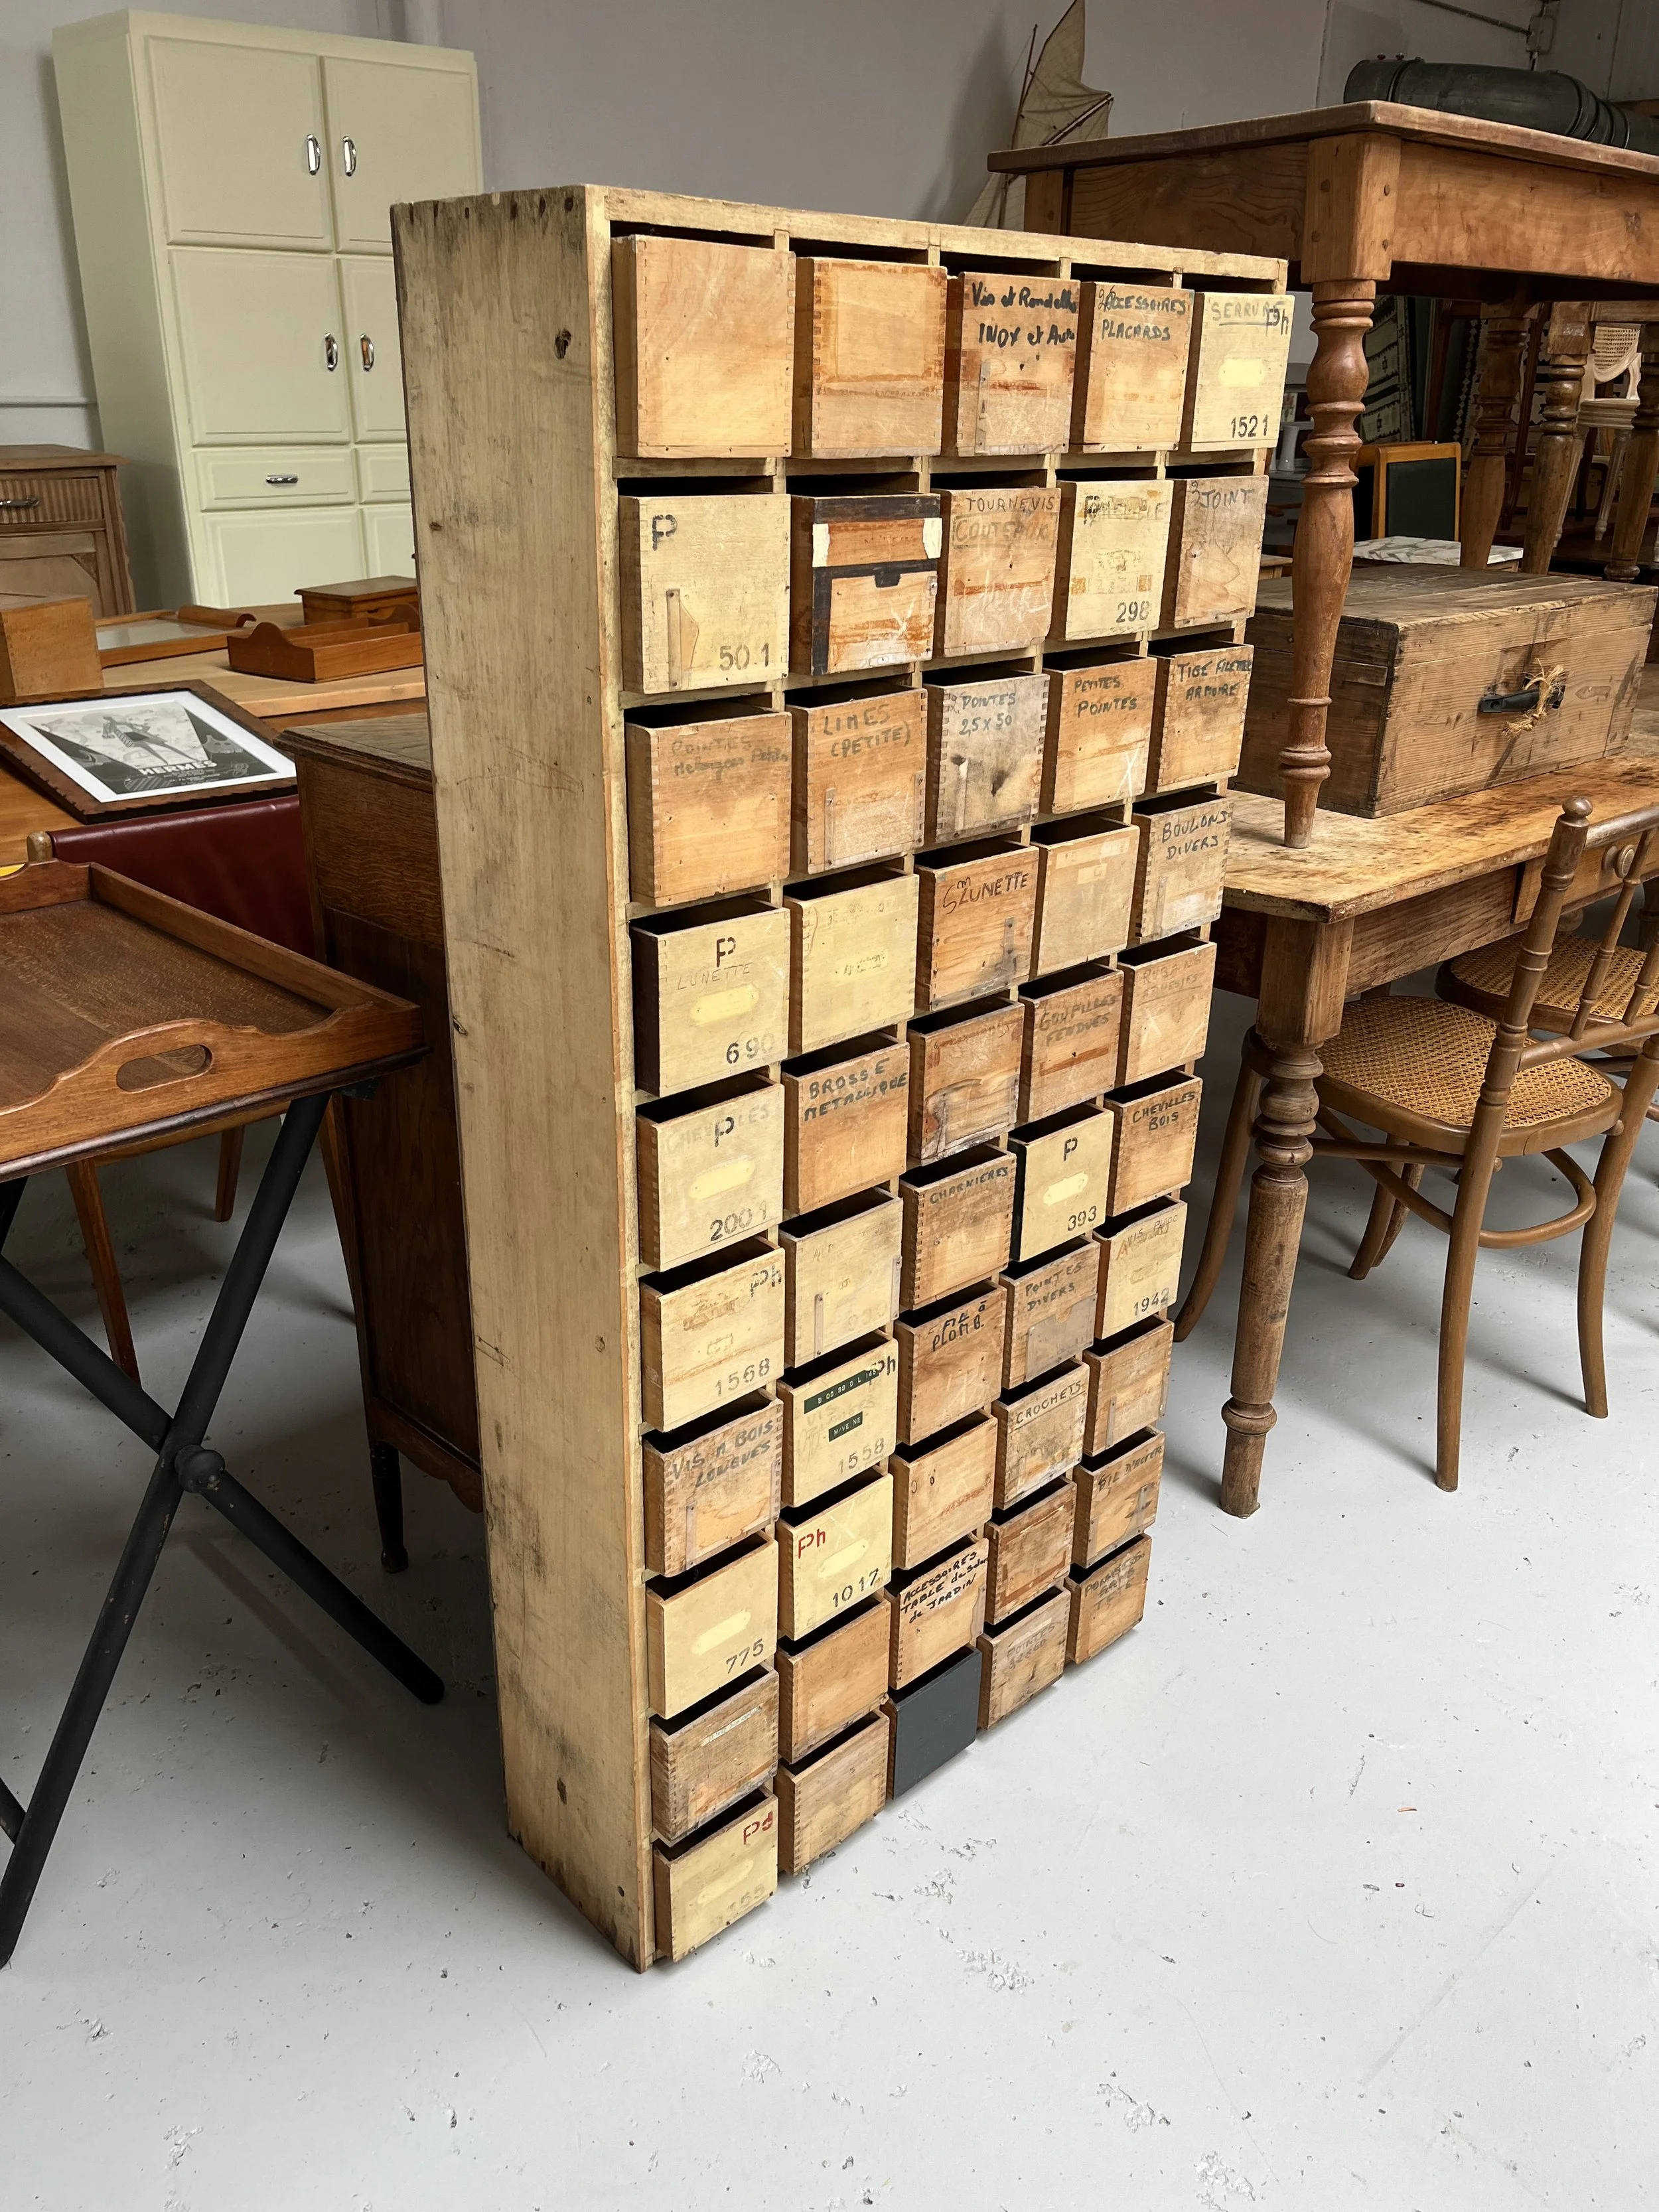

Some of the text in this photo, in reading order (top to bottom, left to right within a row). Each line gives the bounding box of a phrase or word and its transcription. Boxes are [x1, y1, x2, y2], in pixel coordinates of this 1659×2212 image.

[1001, 286, 1016, 307] et
[1028, 325, 1043, 346] et
[1102, 319, 1170, 340] PLACARDS
[1232, 415, 1267, 438] 1521
[966, 496, 1055, 512] TOURNEVIS
[1200, 488, 1254, 510] JOINT
[652, 514, 678, 551] P
[1116, 601, 1150, 623] 298
[719, 642, 769, 671] 501
[1177, 660, 1212, 682] TIGE
[1074, 676, 1121, 693] PETITES
[1186, 682, 1240, 700] ARMOIRE
[961, 693, 1016, 709] POINTES
[1078, 697, 1137, 717] POINTES
[824, 703, 891, 735] LIMES
[831, 721, 910, 758] (PETITE)
[1162, 810, 1228, 844] BOULONS
[1167, 835, 1218, 860] DIVERS
[958, 871, 1029, 905] LUNETTE
[717, 937, 736, 968] P
[677, 962, 753, 991] LUNETTE
[726, 1032, 776, 1065] 690
[809, 1057, 890, 1100] BROSSE
[1133, 1091, 1196, 1123] CHEVILLES
[1149, 1111, 1179, 1132] BOIS
[714, 1117, 735, 1147] P
[1063, 1138, 1078, 1162] P
[930, 1166, 1009, 1205] CHARNIERES
[1067, 1205, 1097, 1232] 393
[1025, 1262, 1082, 1297] POINTES
[1027, 1282, 1075, 1312] DIVERS
[1133, 1287, 1169, 1317] 1942
[715, 1358, 770, 1397] 1568
[1016, 1380, 1082, 1425] CROCHETS
[672, 1453, 705, 1479] VIS
[735, 1420, 774, 1447] BOIS
[695, 1440, 771, 1488] LONGUES
[798, 1528, 826, 1559] Ph
[832, 1568, 879, 1607] 1017
[903, 1552, 977, 1605] ACCESSOIRES
[901, 1582, 945, 1613] TABLE
[909, 1573, 977, 1623] de JARDIN
[726, 1639, 764, 1674] 775
